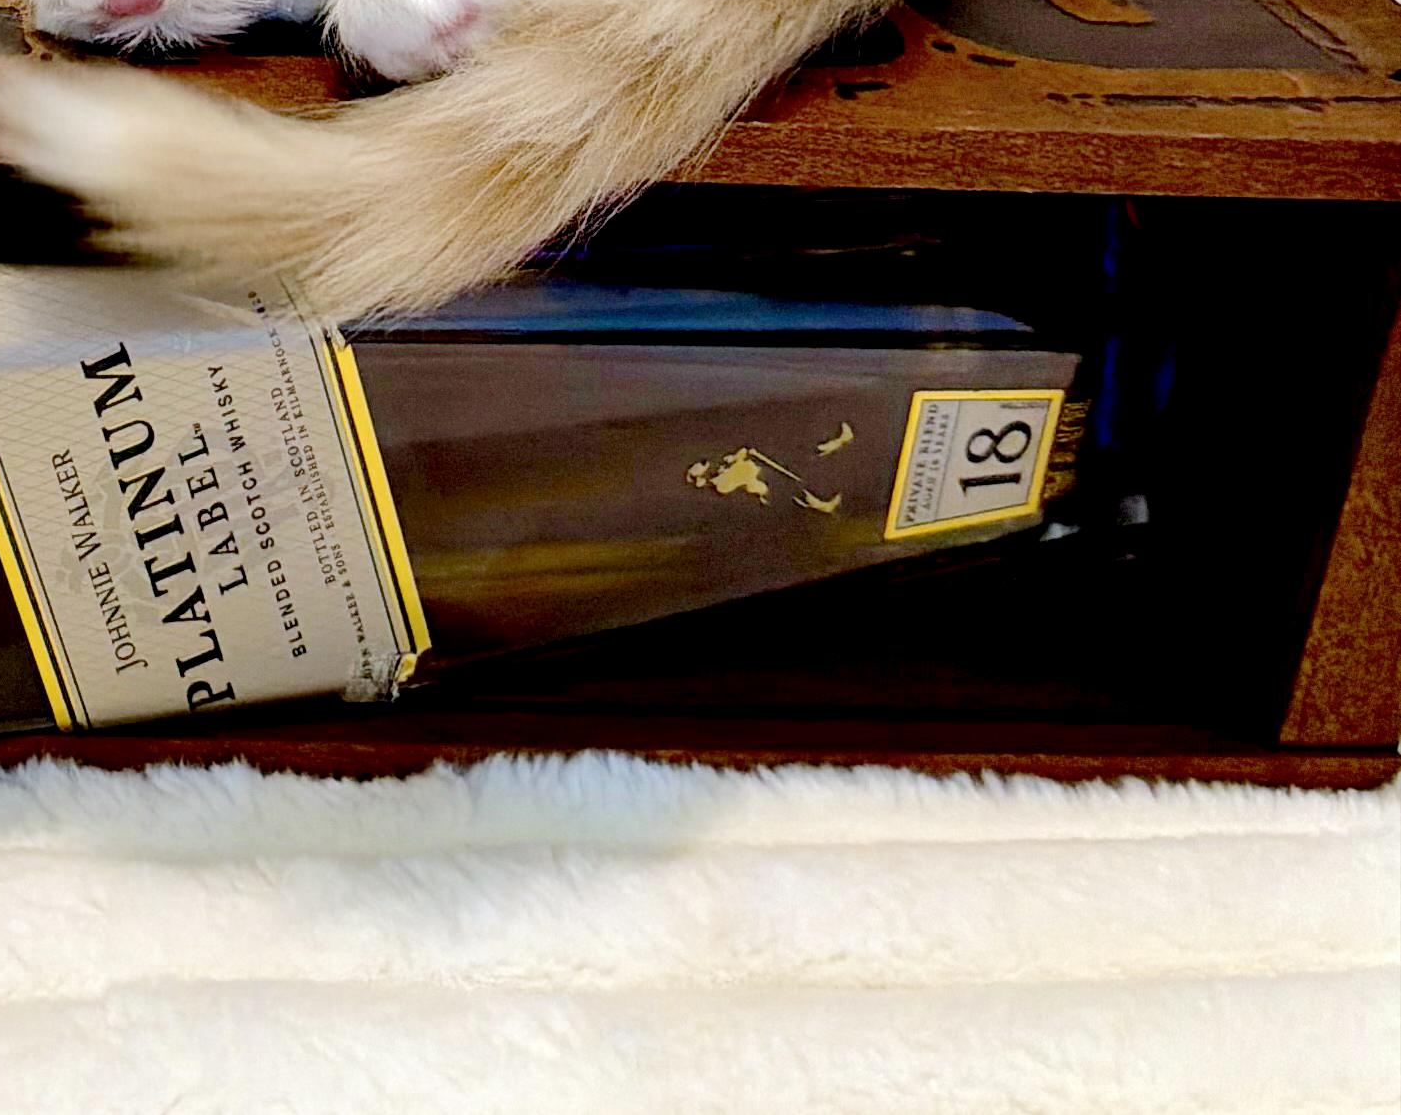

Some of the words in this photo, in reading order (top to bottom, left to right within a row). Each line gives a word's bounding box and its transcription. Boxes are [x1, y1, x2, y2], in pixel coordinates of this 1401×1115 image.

[207, 363, 249, 452] WHISKY
[267, 327, 306, 419] KILMARNOCK
[270, 387, 306, 478] SCOTLAND
[298, 427, 311, 439] IN
[919, 404, 938, 454] BLEND
[958, 421, 1031, 496] 18
[51, 448, 98, 562] WALKER
[80, 342, 237, 711] PLATINUM
[237, 460, 275, 550] SCOTCH
[296, 484, 313, 503] IN
[301, 444, 336, 530] ESTABLISHED
[304, 510, 336, 584] BOTTLED
[330, 543, 349, 576] SONS
[85, 561, 148, 675] JOHNNIE
[265, 558, 307, 657] BLENDED
[344, 591, 370, 643] WALKER
